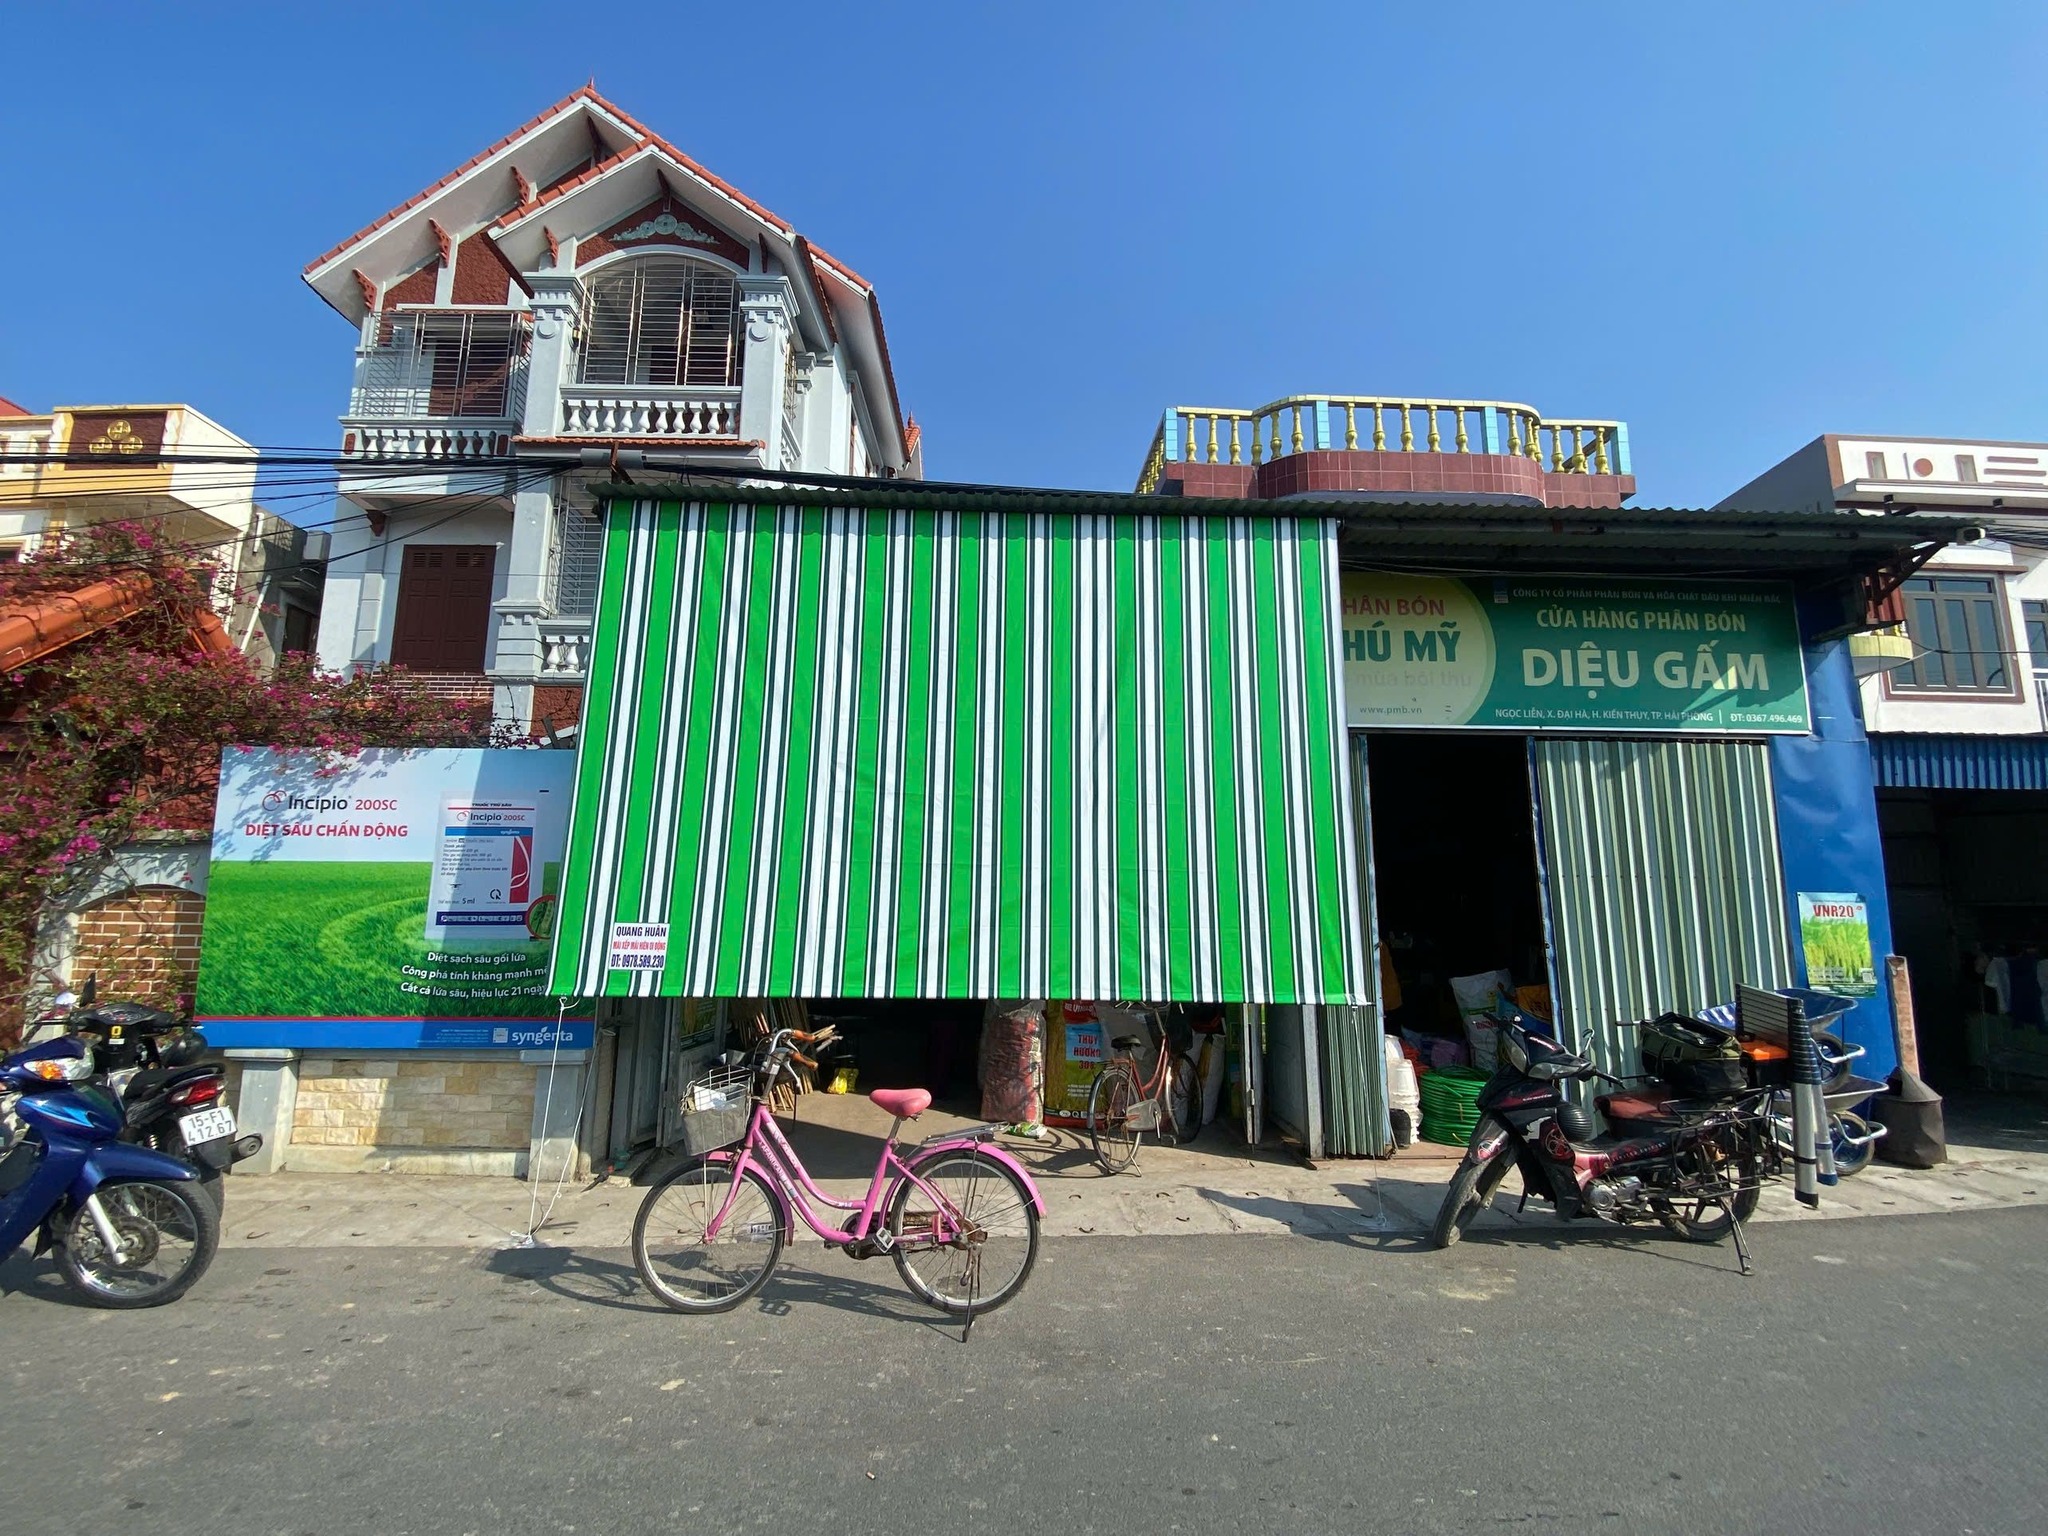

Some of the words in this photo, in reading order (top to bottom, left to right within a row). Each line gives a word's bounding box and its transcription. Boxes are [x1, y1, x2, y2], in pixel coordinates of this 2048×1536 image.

[1540, 589, 1550, 597] TY
[1342, 595, 1390, 615] HÂN
[1397, 595, 1444, 616] BÓN
[1536, 604, 1577, 628] CỬA
[1582, 607, 1639, 629] HÀNG
[1644, 609, 1699, 631] PHÂN
[1704, 610, 1746, 632] BÓN
[1343, 621, 1391, 662] HÚ
[1404, 621, 1461, 662] MỸ
[1522, 641, 1640, 699] DIỆU
[1653, 640, 1770, 691] GẤM
[1360, 706, 1422, 714] www.pmb.vn
[1495, 709, 1521, 720] NGỌC
[1547, 710, 1555, 718] X.
[1557, 710, 1573, 720] ĐẠI
[1592, 710, 1601, 719] H.
[1651, 711, 1662, 720] TP.
[1730, 713, 1745, 722] ĐT:
[1746, 714, 1802, 723] 0367.496.469
[288, 795, 348, 813] Incipio
[355, 799, 398, 810] 200SC
[470, 813, 502, 822] Incipio
[245, 822, 279, 839] DIỆT
[282, 822, 312, 836] SÂU
[316, 820, 360, 837] CHẤN
[364, 822, 408, 840] ĐỘNG
[1813, 905, 1854, 917] VNR20
[616, 926, 642, 937] QUANG
[428, 952, 448, 964] Diệt
[450, 954, 472, 965] sạch
[475, 954, 491, 964] sâu
[511, 953, 526, 962] lứa
[402, 965, 428, 979] Công
[429, 969, 448, 980] phá
[450, 971, 469, 980] tính
[472, 971, 502, 982] kháng
[505, 968, 532, 980] mạnh
[401, 982, 418, 993] Cắt
[420, 985, 430, 995] cả
[432, 986, 447, 996] lứa
[449, 989, 469, 1000] sâu,
[472, 988, 492, 1000] hiệu
[494, 988, 509, 999] lực
[511, 986, 521, 996] 21
[512, 1029, 573, 1045] syngenta
[188, 1110, 224, 1128] 15-F1
[188, 1120, 232, 1142] 412.67
